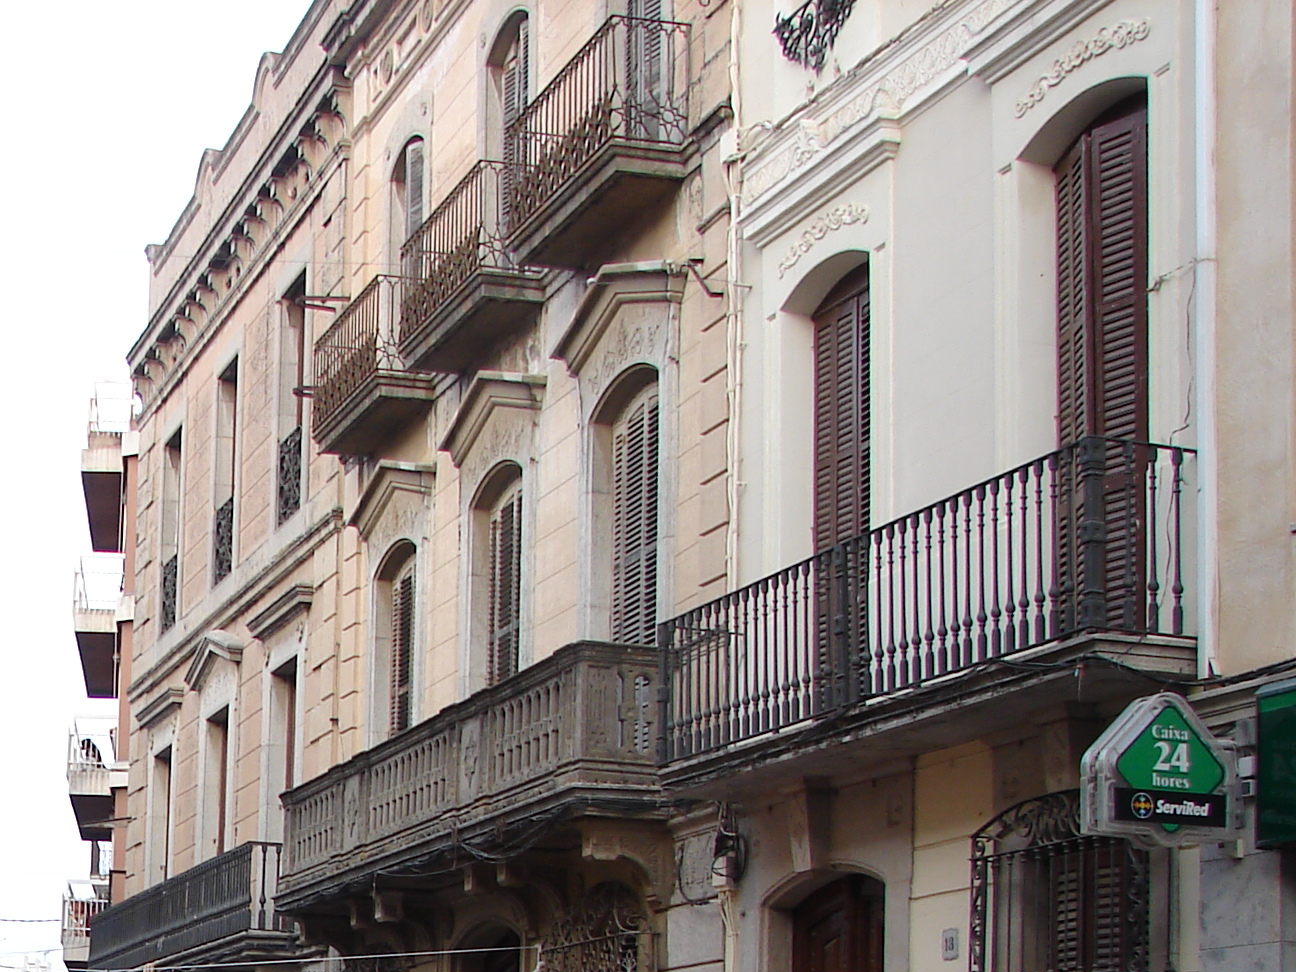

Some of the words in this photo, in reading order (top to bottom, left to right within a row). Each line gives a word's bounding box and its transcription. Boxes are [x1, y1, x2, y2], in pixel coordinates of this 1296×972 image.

[1152, 724, 1189, 741] Caixa
[1153, 741, 1189, 773] 24
[1152, 772, 1189, 788] hores
[1155, 799, 1209, 817] ServiRed
